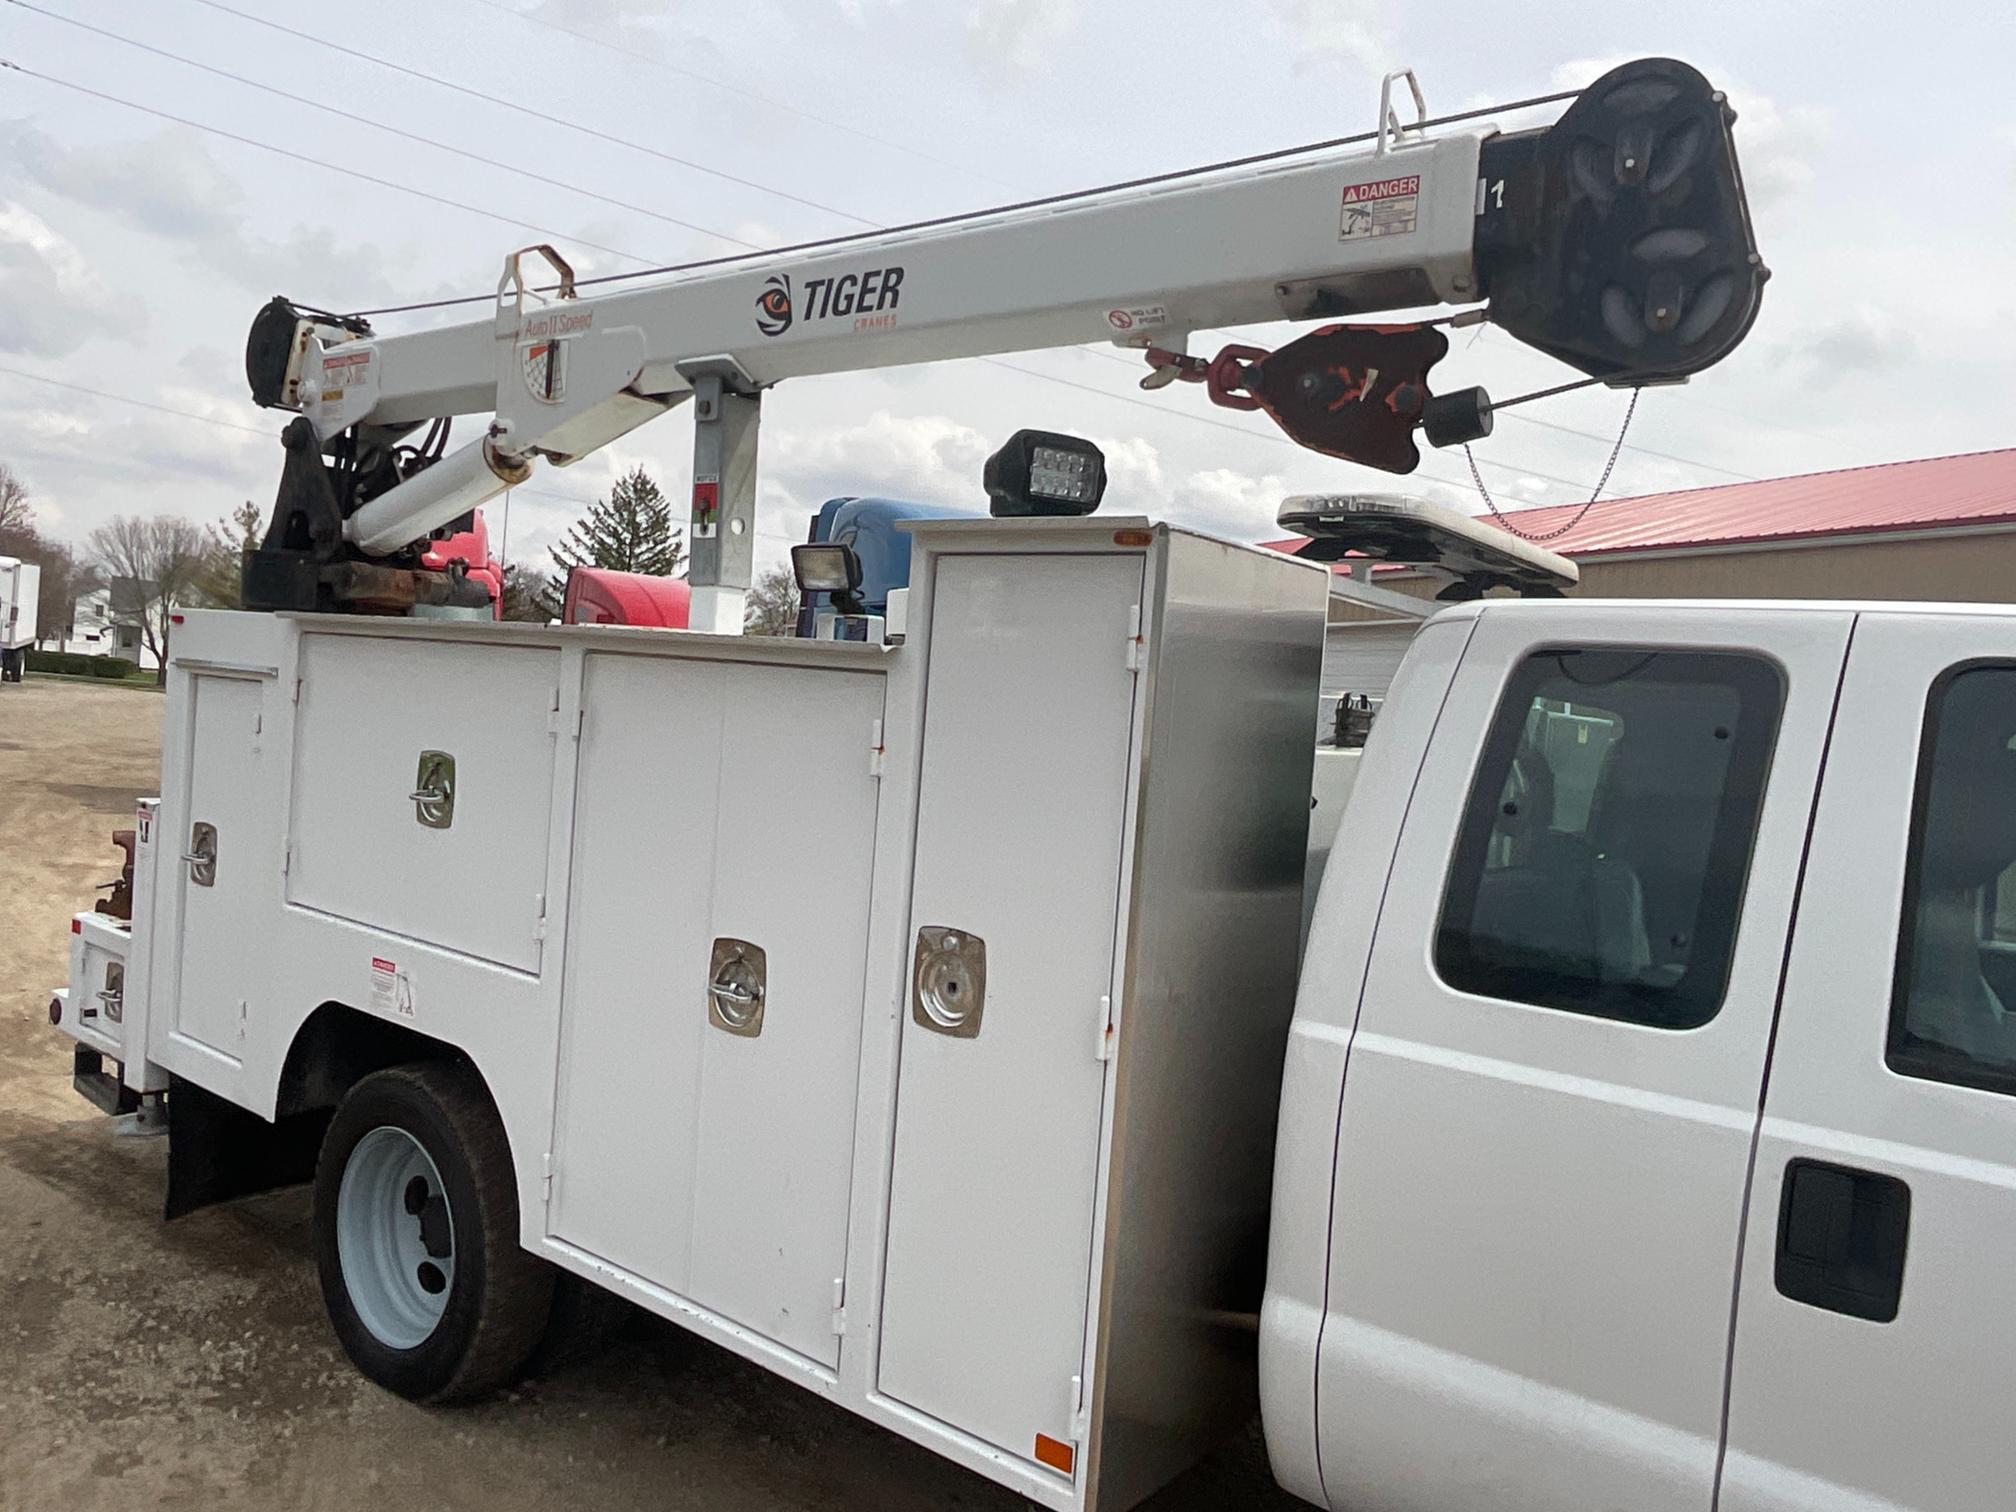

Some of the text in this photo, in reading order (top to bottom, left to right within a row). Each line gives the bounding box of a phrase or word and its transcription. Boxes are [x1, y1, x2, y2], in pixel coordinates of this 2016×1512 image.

[1359, 178, 1418, 200] DANGER
[1490, 179, 1504, 208] 1
[803, 266, 904, 321] TIGER
[854, 314, 896, 331] CRANES
